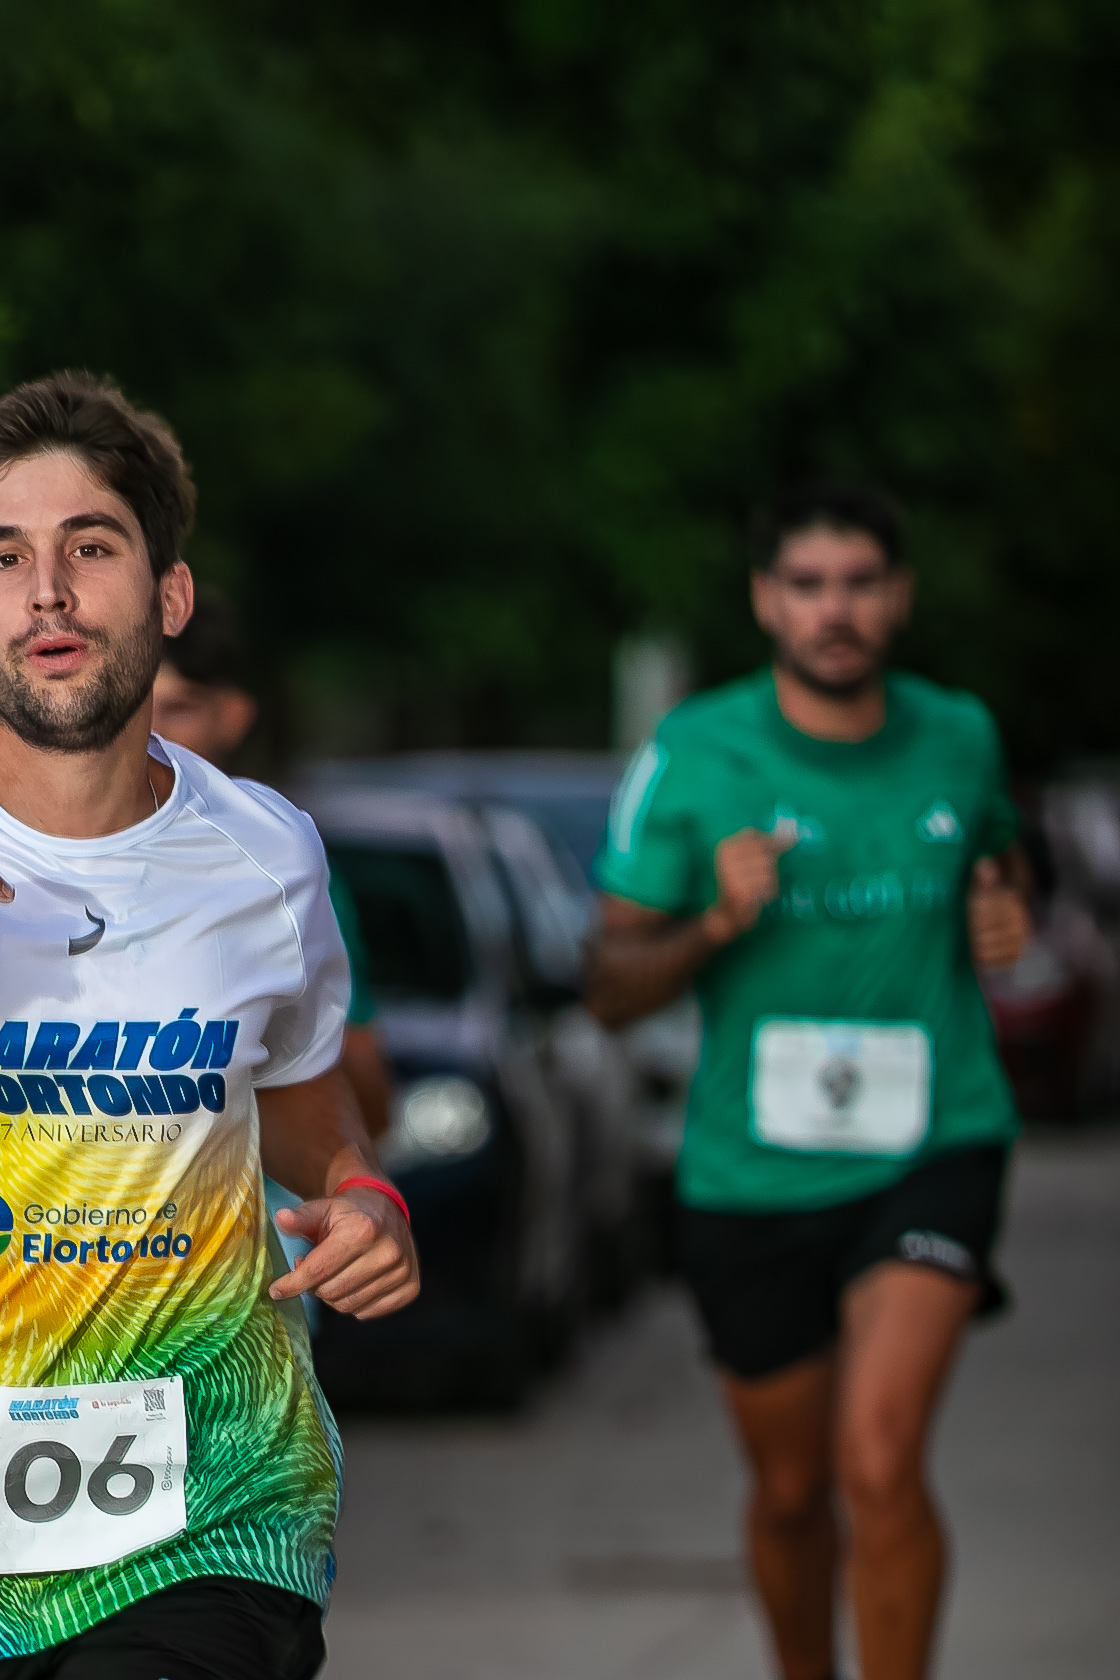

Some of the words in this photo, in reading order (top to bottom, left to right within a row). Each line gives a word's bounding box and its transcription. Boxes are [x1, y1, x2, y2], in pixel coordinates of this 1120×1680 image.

[20, 1122, 183, 1143] ANIVERSARIO
[23, 1202, 148, 1225] Gobierno
[154, 1201, 179, 1221] e
